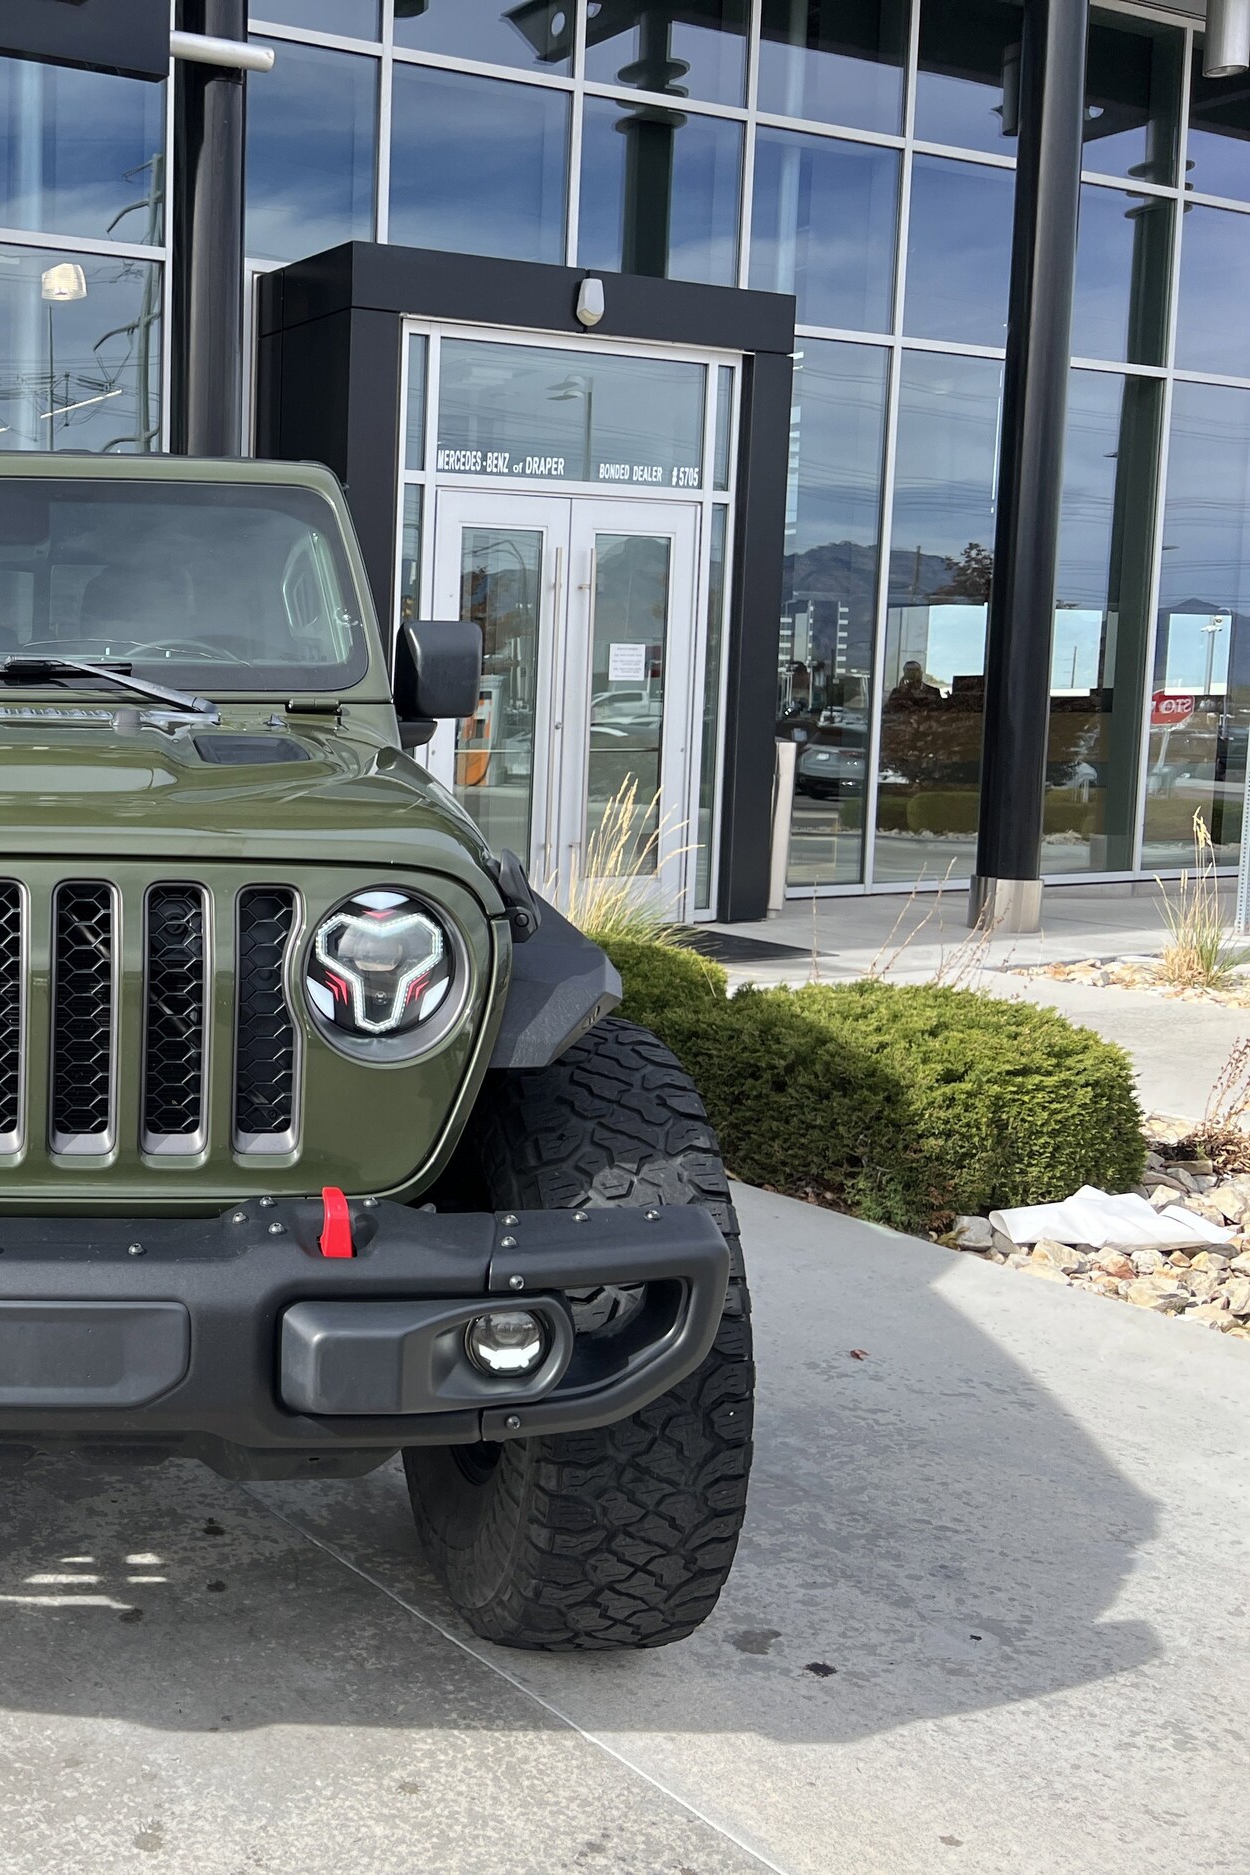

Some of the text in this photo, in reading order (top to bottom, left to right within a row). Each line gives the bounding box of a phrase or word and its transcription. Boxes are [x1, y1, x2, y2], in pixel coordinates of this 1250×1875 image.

[513, 463, 524, 473] of
[525, 456, 565, 475] DRAPER
[599, 463, 630, 480] BONDED
[632, 465, 663, 482] DEALER
